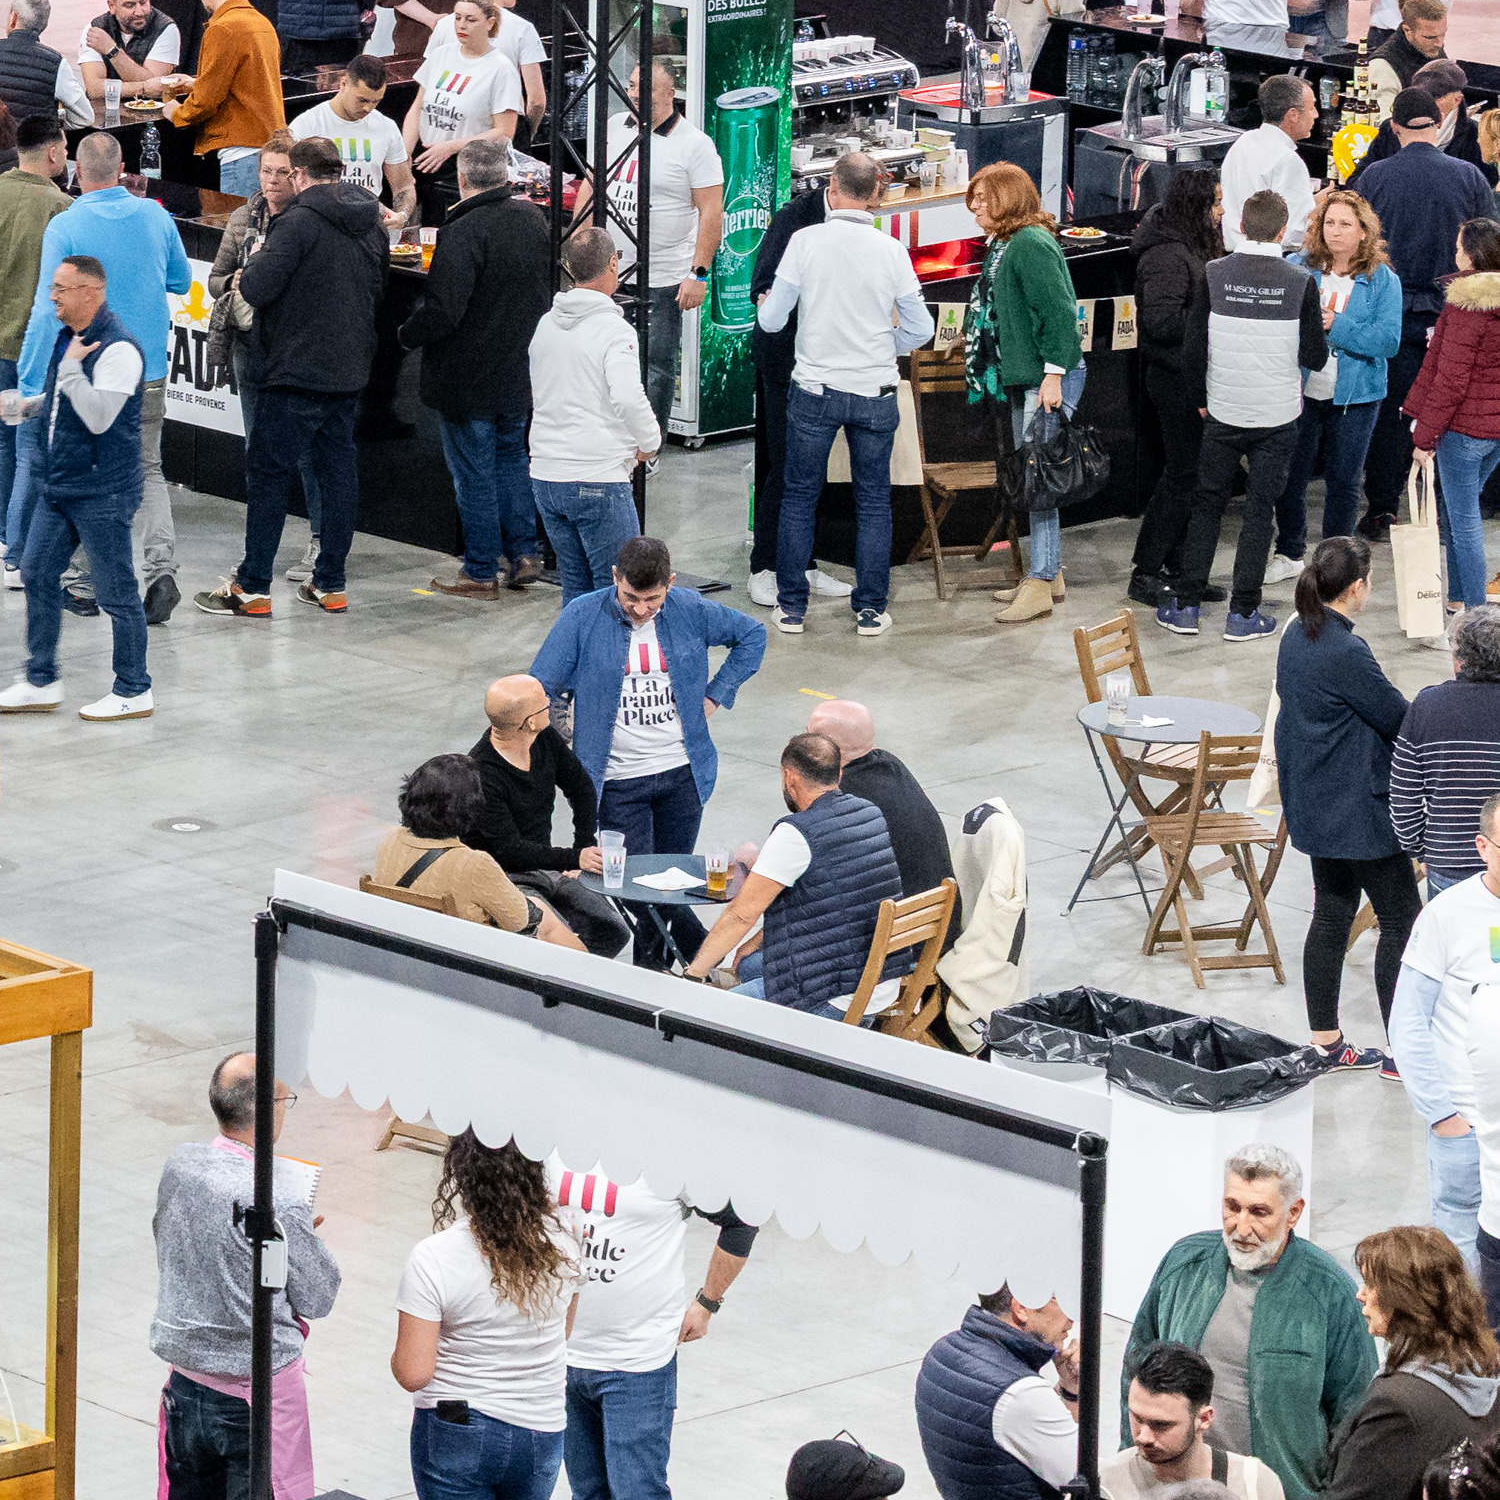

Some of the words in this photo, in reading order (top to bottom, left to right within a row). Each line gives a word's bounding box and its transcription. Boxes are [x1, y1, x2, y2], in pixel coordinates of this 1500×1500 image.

[708, 8, 763, 23] EXTRAORDINAIRES
[434, 92, 450, 106] La
[342, 164, 362, 177] La
[1224, 283, 1257, 294] MAISON
[1258, 287, 1286, 296] GILLOT
[1117, 319, 1134, 335] FADA
[185, 393, 194, 403] DE
[195, 396, 226, 411] PROVENCE
[631, 678, 658, 693] La
[624, 708, 675, 726] Place
